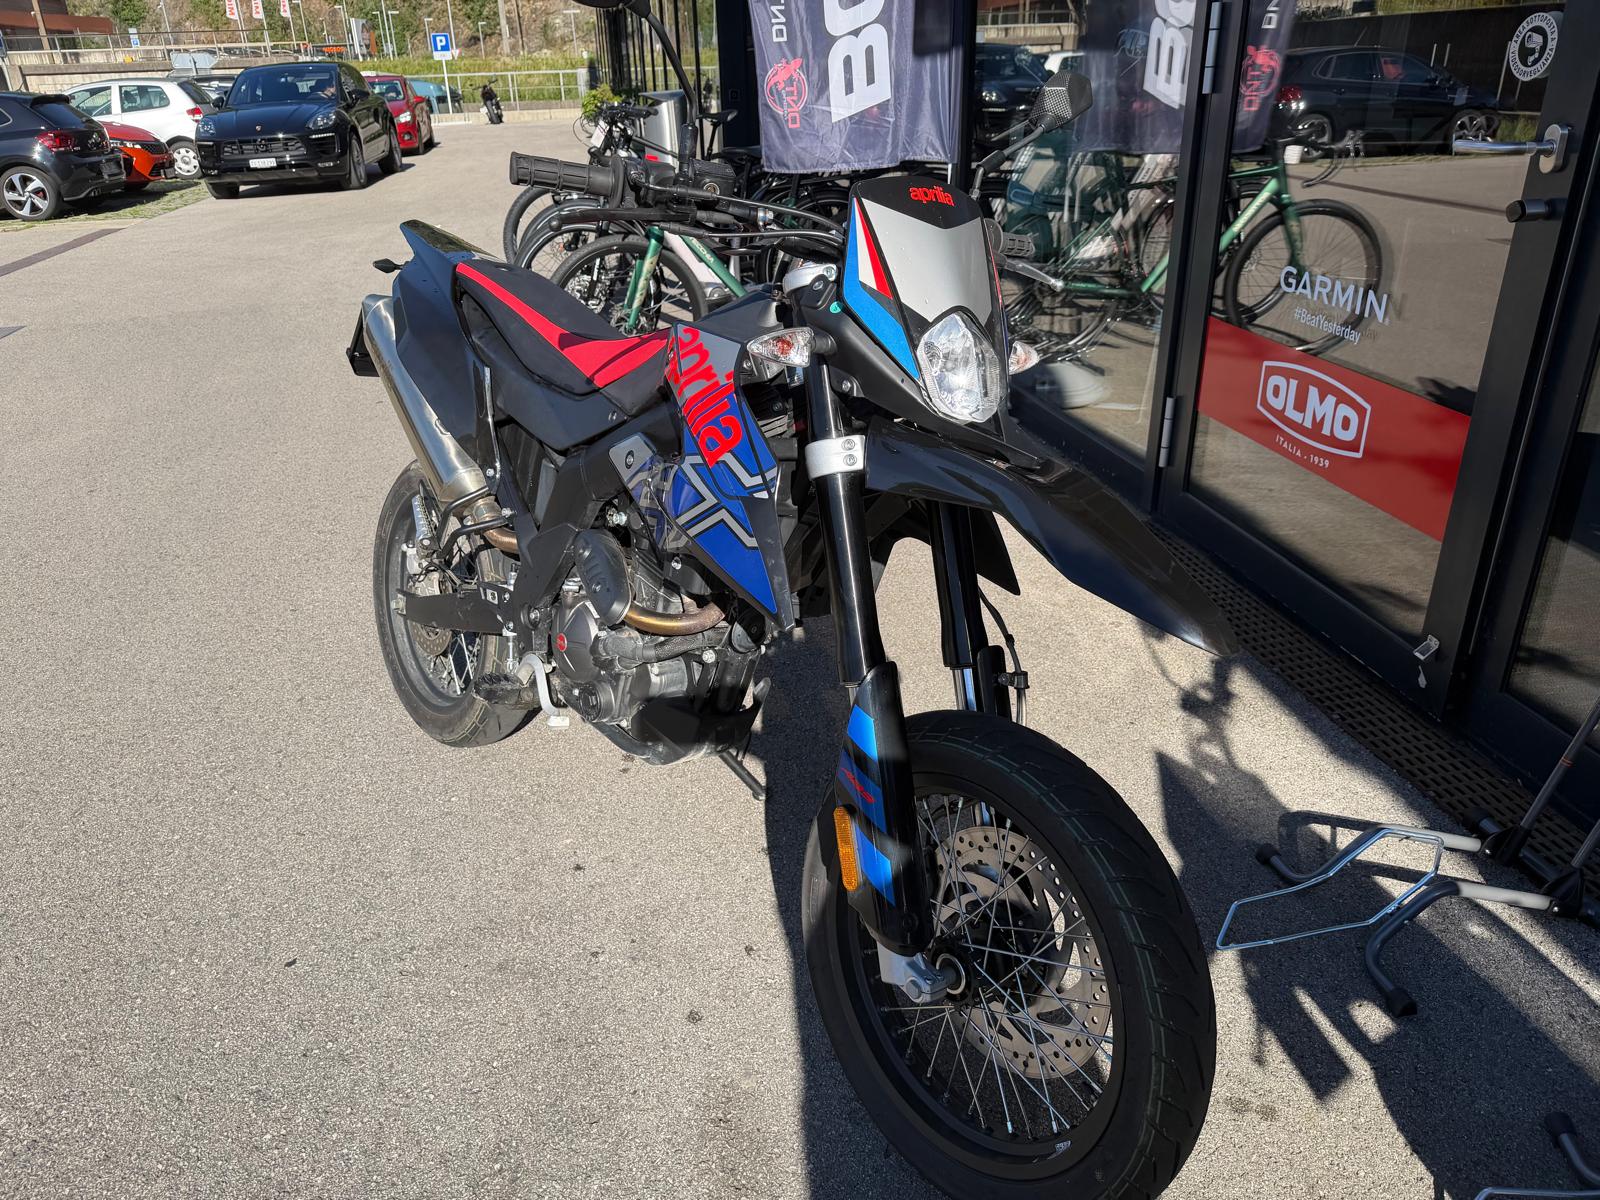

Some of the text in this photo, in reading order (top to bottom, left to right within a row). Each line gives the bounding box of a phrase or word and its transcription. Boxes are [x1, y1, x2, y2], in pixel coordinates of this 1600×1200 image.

[436, 36, 447, 51] P
[1513, 25, 1526, 44] AREA
[1526, 15, 1557, 36] SOTTOPOSTA
[1511, 47, 1555, 78] VIDEOSORVEGLIANZA
[909, 185, 955, 207] aprilia
[1280, 266, 1388, 323] GARMIN
[1294, 306, 1361, 345] #BeatYesterday
[666, 327, 742, 469] aprilia
[1266, 375, 1359, 442] OLMO
[1275, 434, 1330, 468] ITALIA 1939
